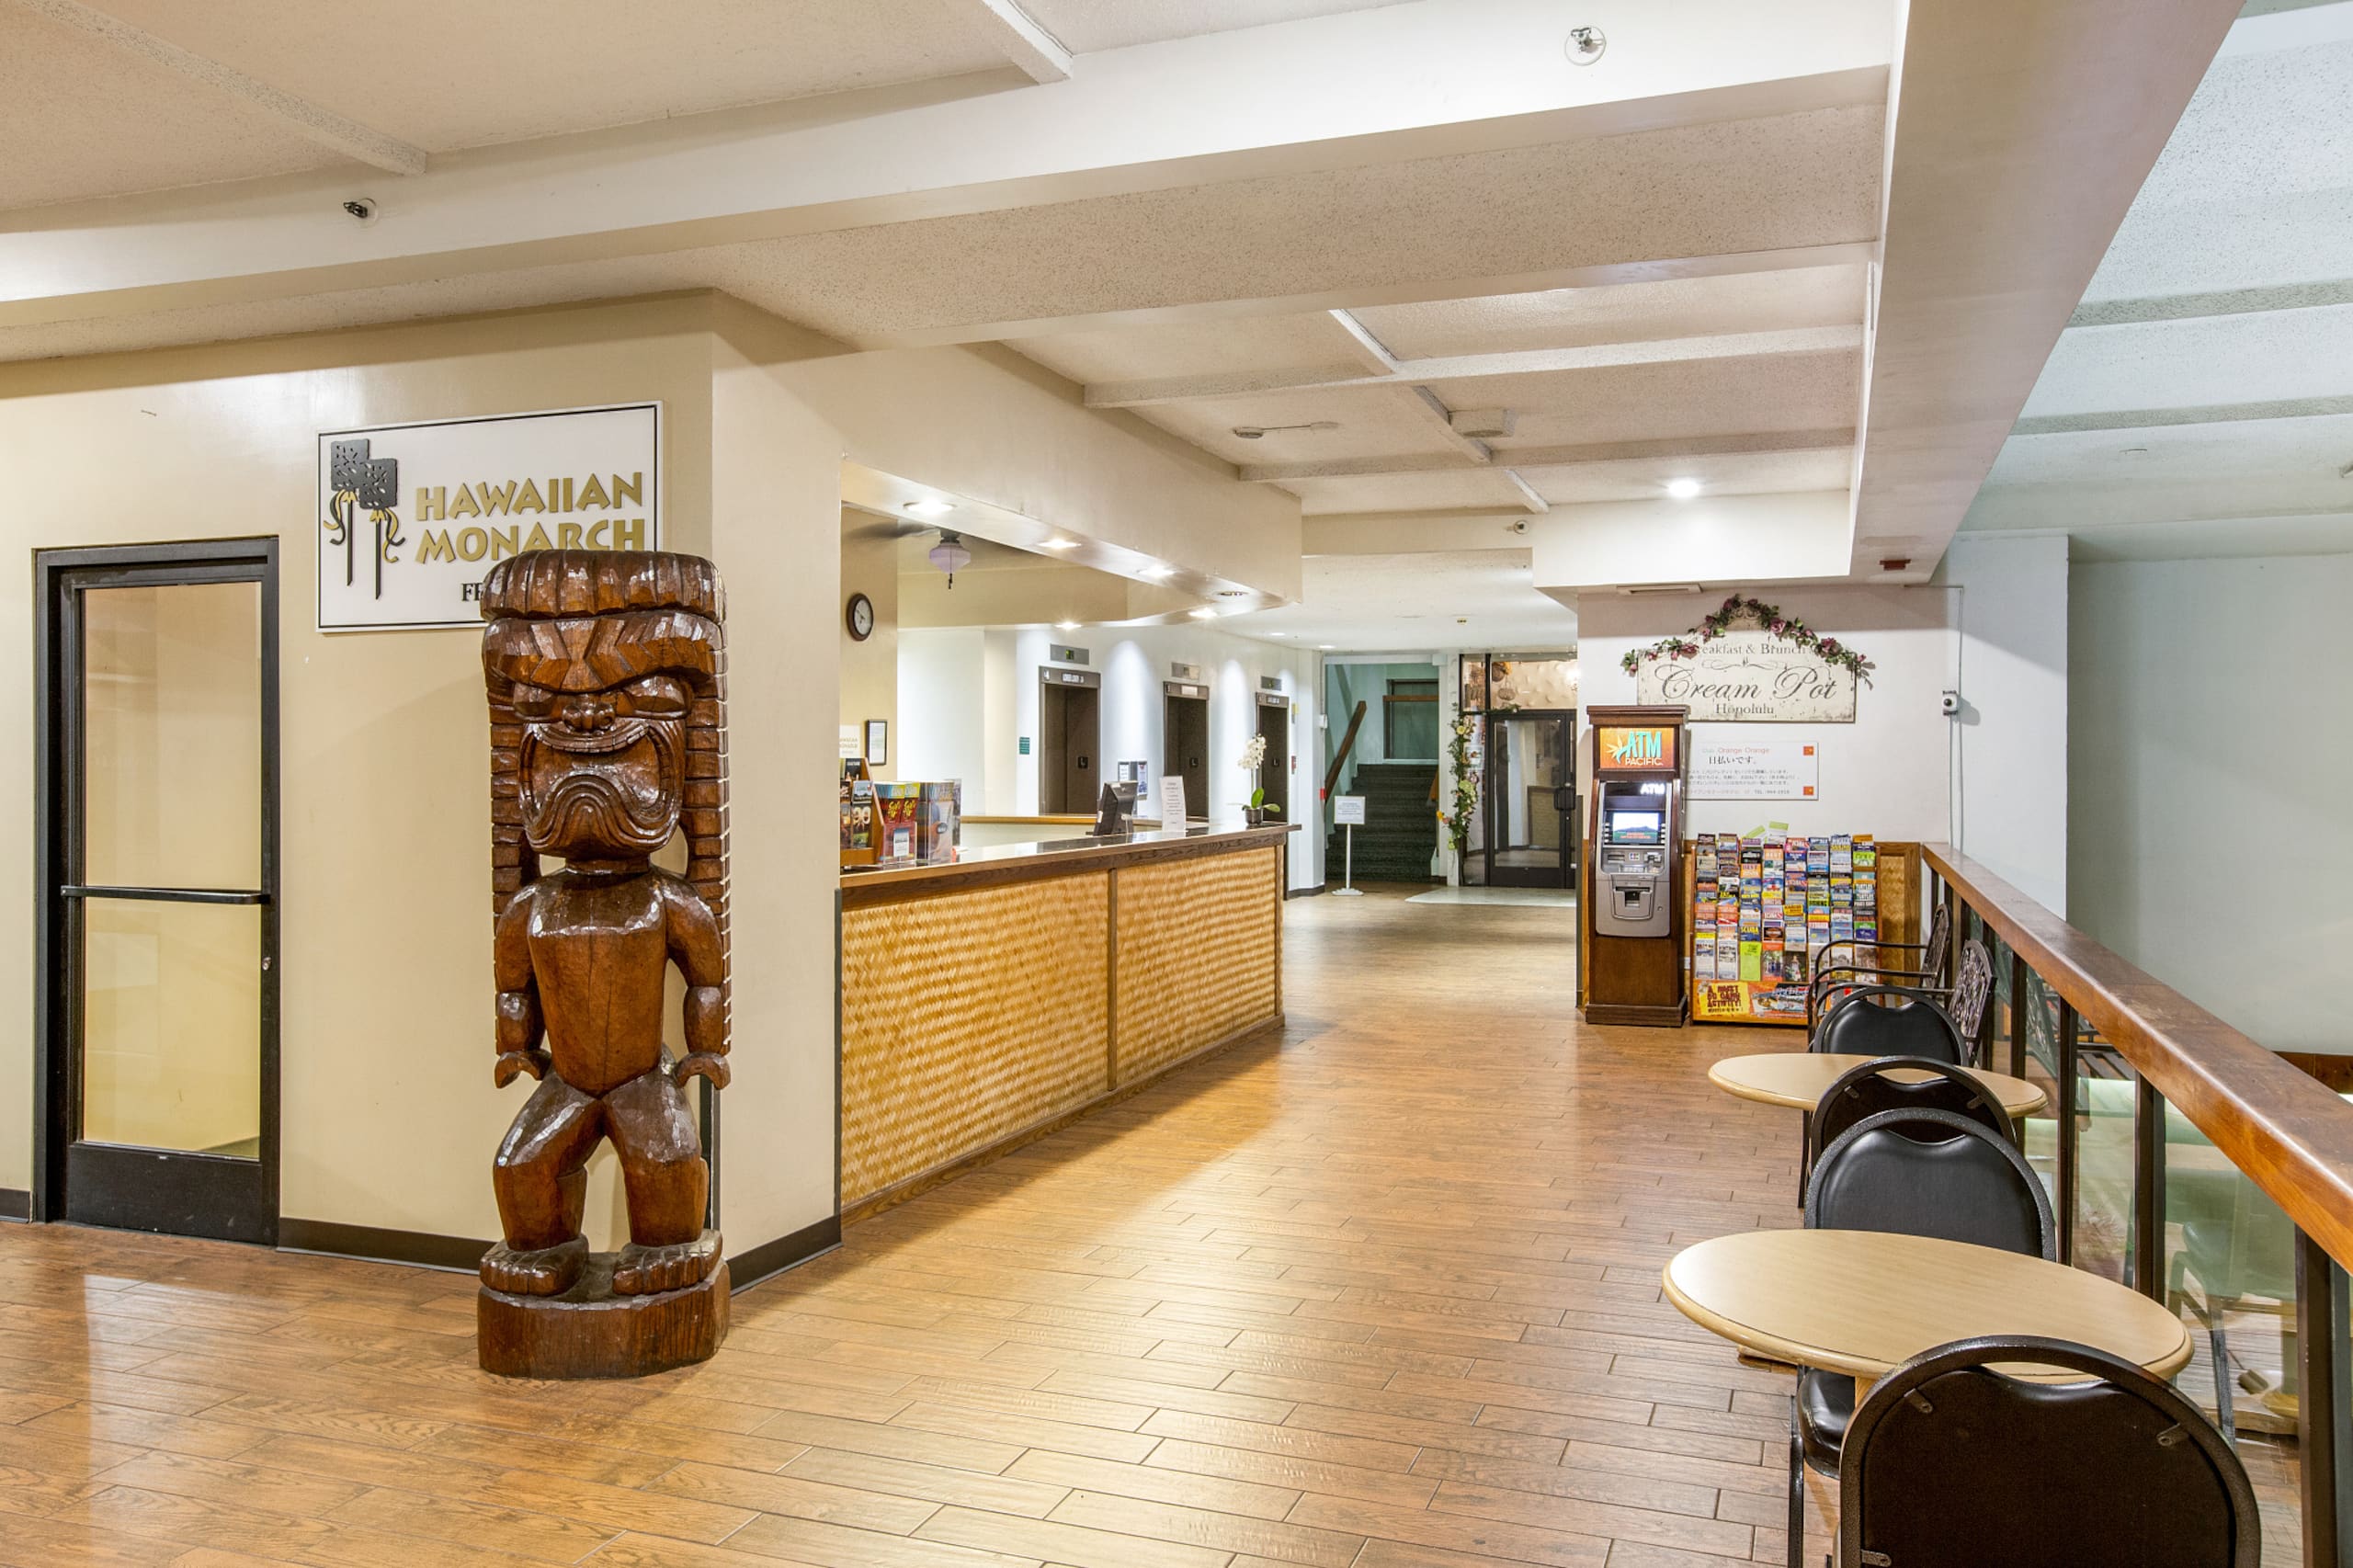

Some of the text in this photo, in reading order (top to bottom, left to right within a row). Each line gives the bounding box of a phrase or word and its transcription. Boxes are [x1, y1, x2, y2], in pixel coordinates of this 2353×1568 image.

[416, 472, 642, 521] HAWAIIAN
[415, 519, 645, 563] MONARCH
[1698, 643, 1806, 654] reakfast & Brunch
[1654, 664, 1837, 699] Cream Pot
[1716, 702, 1774, 714] Honolulu
[1624, 731, 1662, 758] ATM
[1625, 756, 1663, 766] PACIFIC
[1641, 783, 1665, 795] ATM
